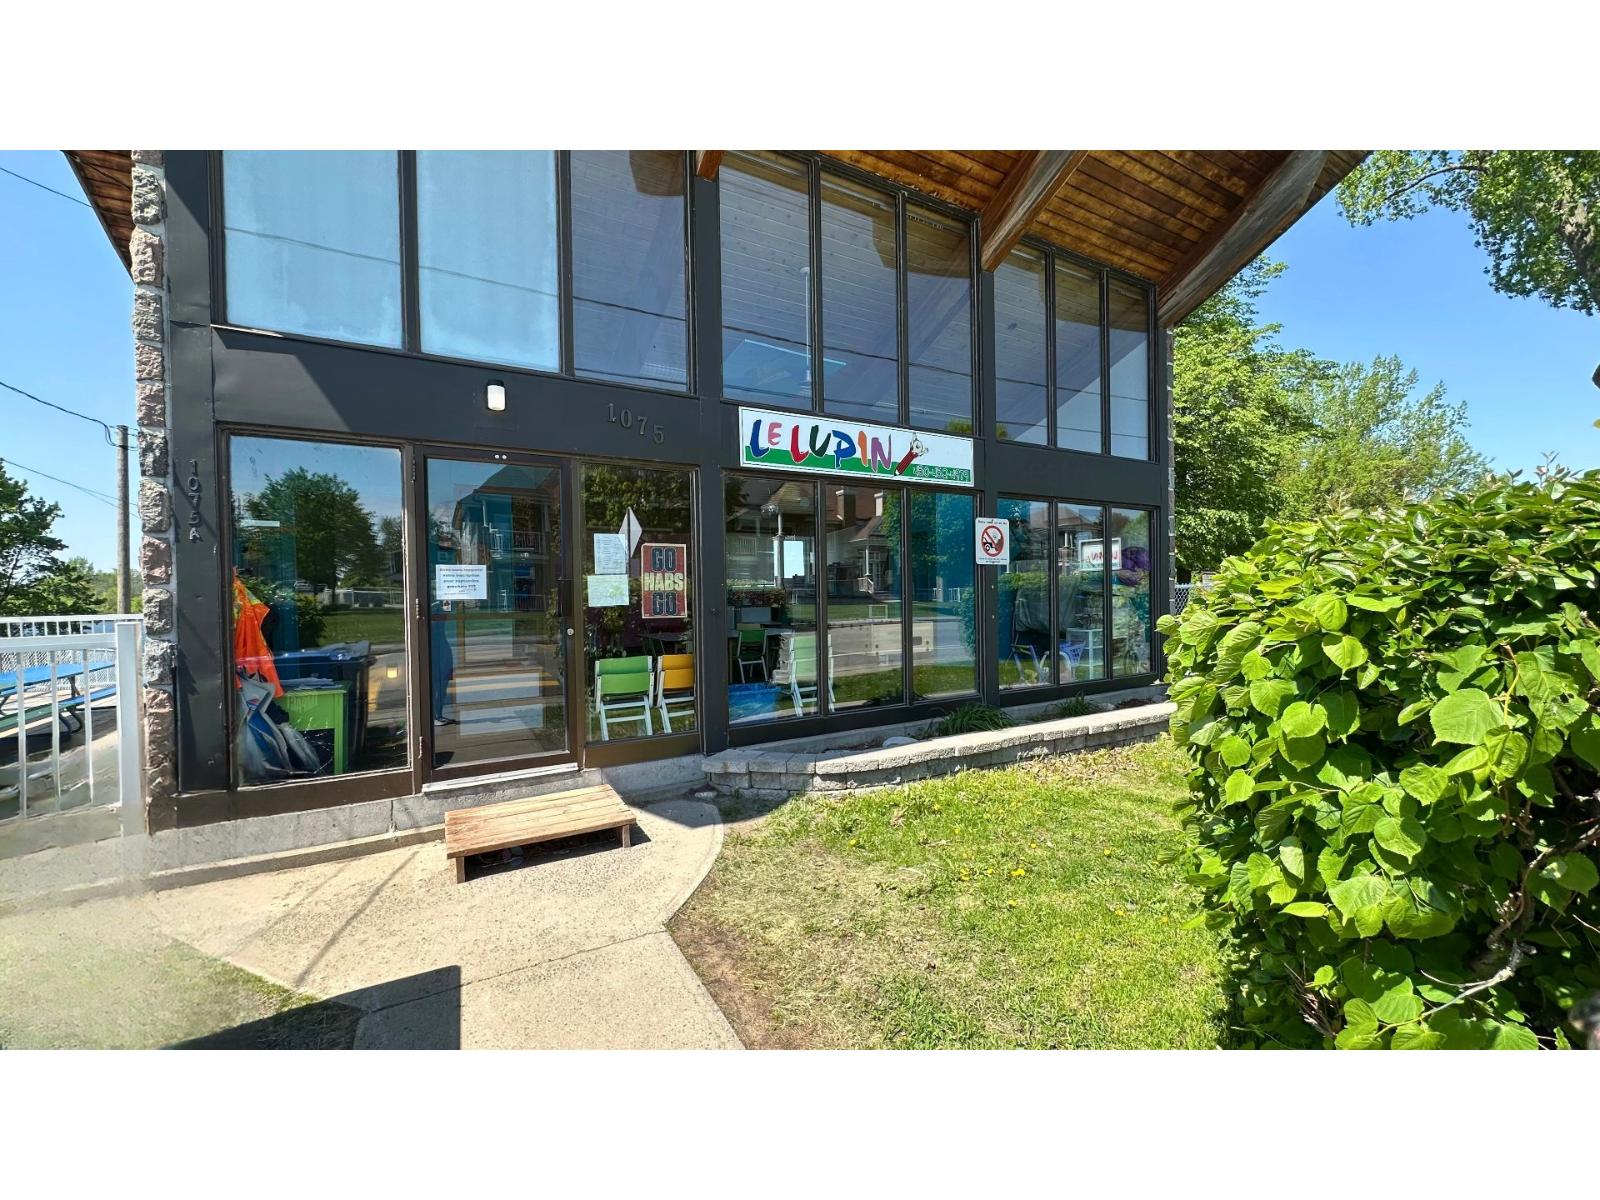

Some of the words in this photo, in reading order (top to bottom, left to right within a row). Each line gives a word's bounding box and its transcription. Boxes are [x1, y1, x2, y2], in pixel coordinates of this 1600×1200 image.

[607, 402, 666, 444] 1075
[790, 423, 892, 473] LUPIN
[651, 547, 677, 572] GO
[644, 572, 684, 591] HABS
[651, 592, 678, 616] GO
